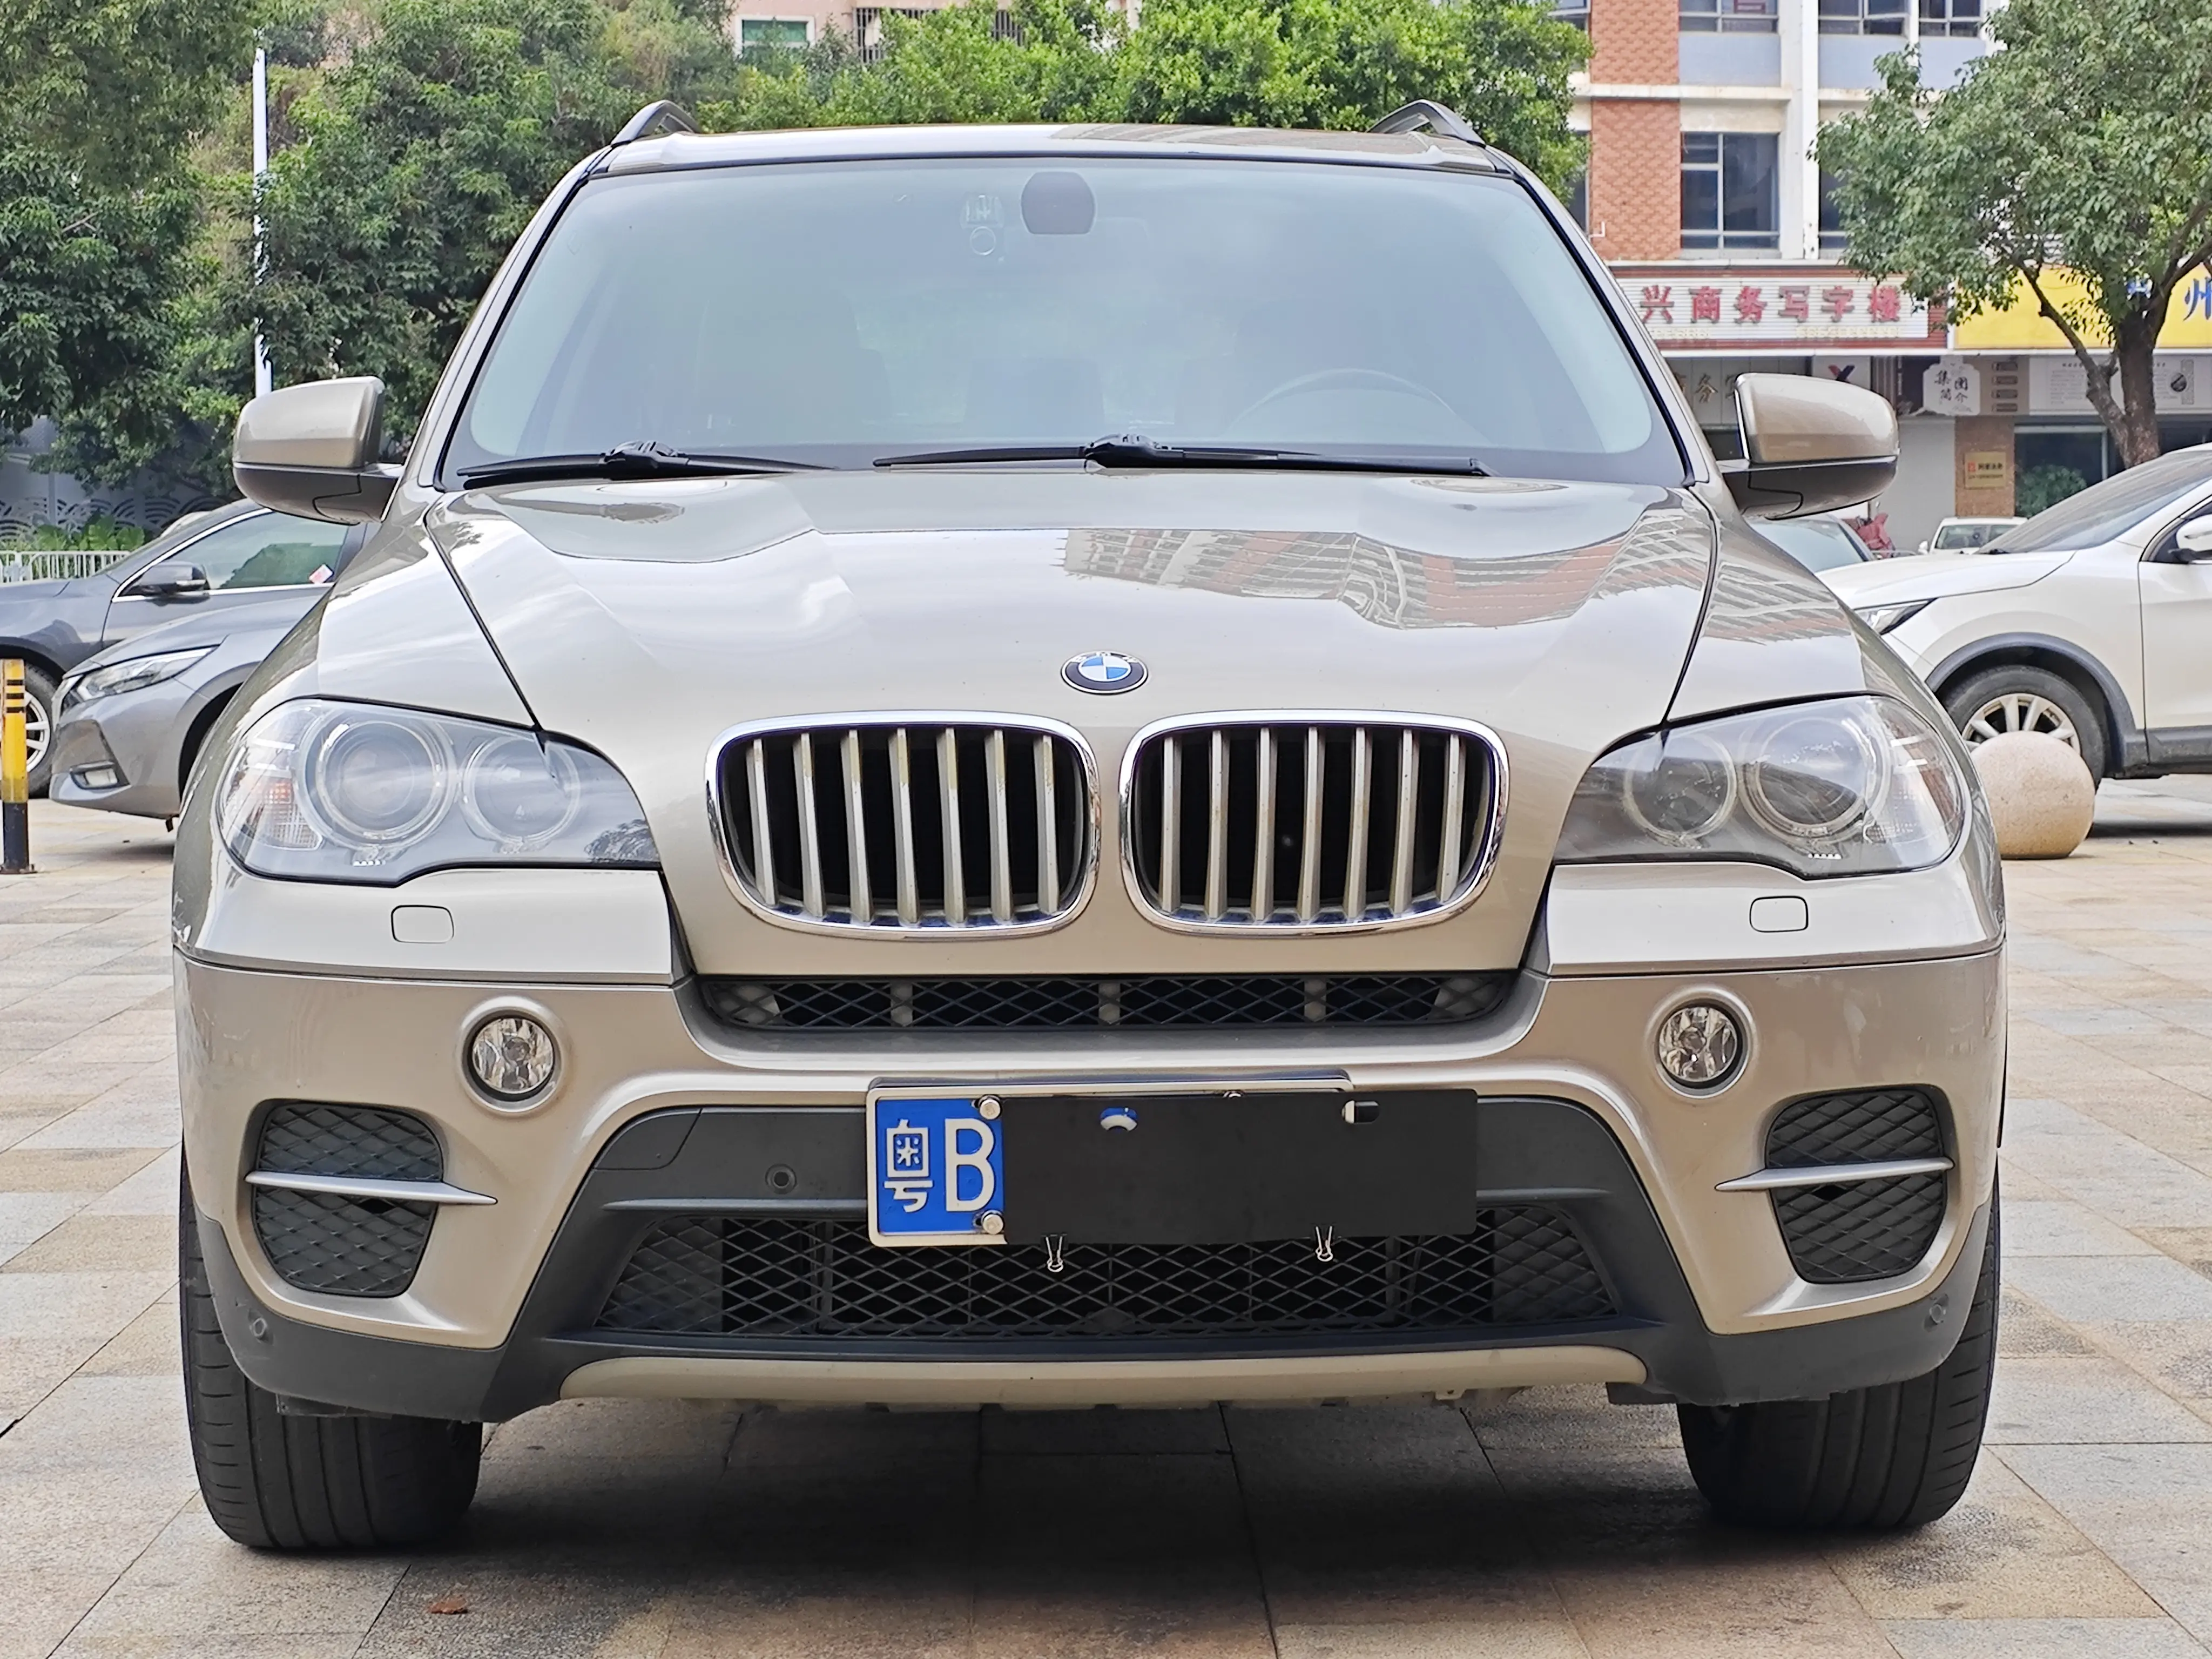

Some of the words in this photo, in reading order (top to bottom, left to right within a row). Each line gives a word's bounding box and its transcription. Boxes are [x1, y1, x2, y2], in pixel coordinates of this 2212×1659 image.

[1640, 284, 1901, 323] 兴商务写字楼
[884, 1118, 995, 1212] 粤B
